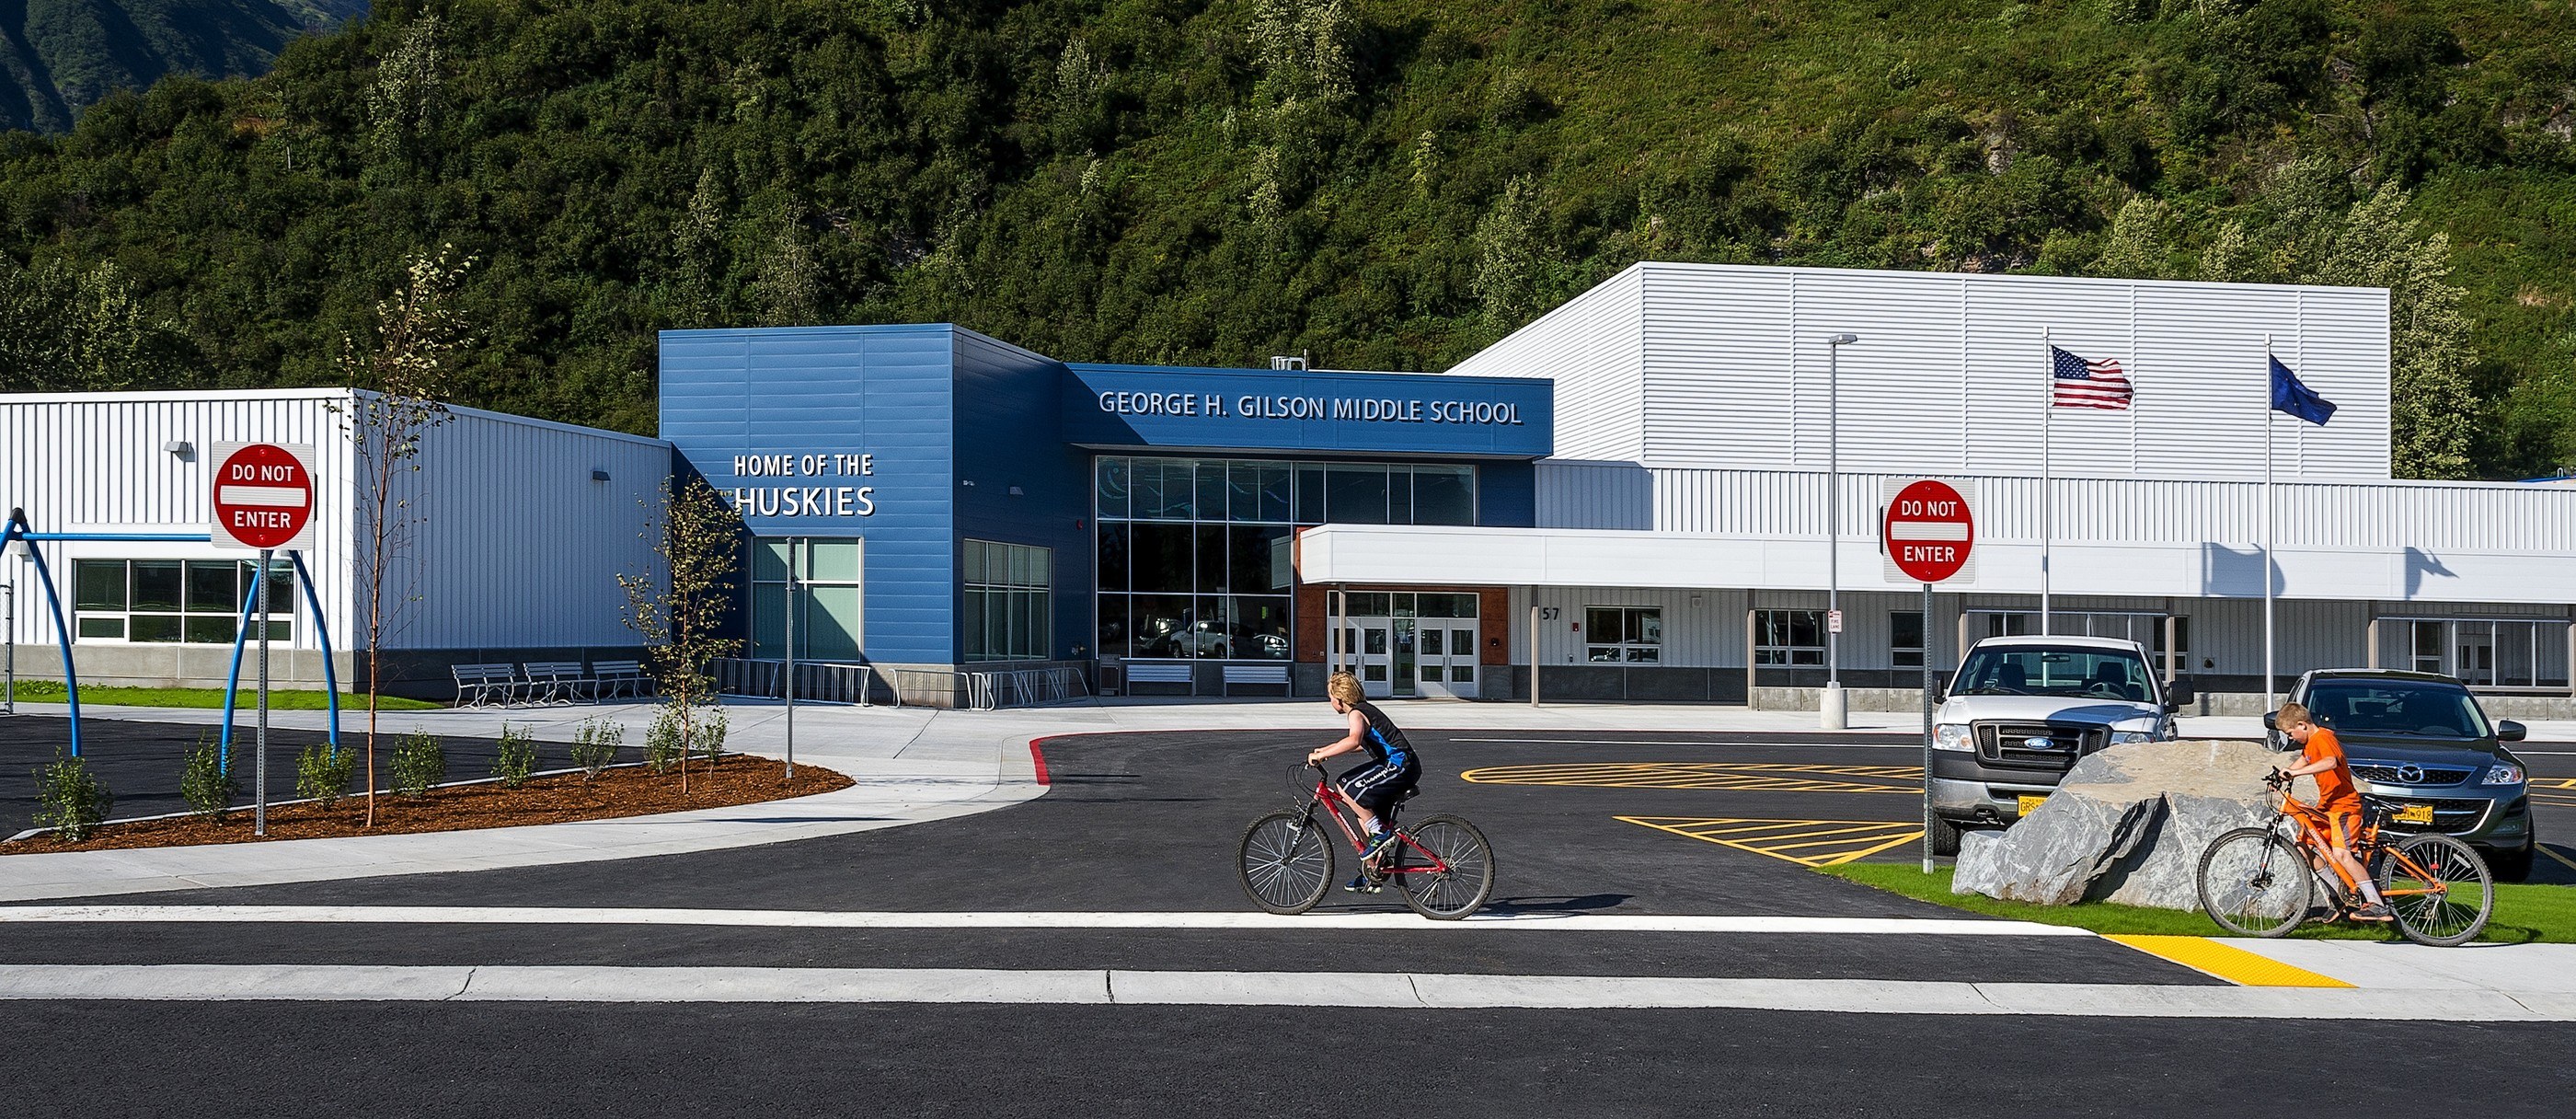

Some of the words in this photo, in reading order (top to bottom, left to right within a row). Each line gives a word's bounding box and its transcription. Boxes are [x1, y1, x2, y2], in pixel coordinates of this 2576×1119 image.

[1099, 391, 1195, 414] GEORGE
[1205, 394, 1227, 416] H.
[1237, 395, 1324, 419] GILSON
[1333, 398, 1421, 421] MIDDLE
[1430, 400, 1523, 424] SCHOOL
[232, 464, 255, 480] DO
[261, 465, 294, 481] NOT
[734, 455, 793, 476] HOME
[801, 455, 827, 476] OF
[834, 454, 872, 475] THE
[735, 486, 875, 516] HUSKIES
[1901, 500, 1922, 516] DO
[1927, 501, 1957, 516] NOT
[235, 511, 291, 528] ENTER
[1903, 546, 1955, 562] ENTER
[1543, 607, 1559, 620] 57
